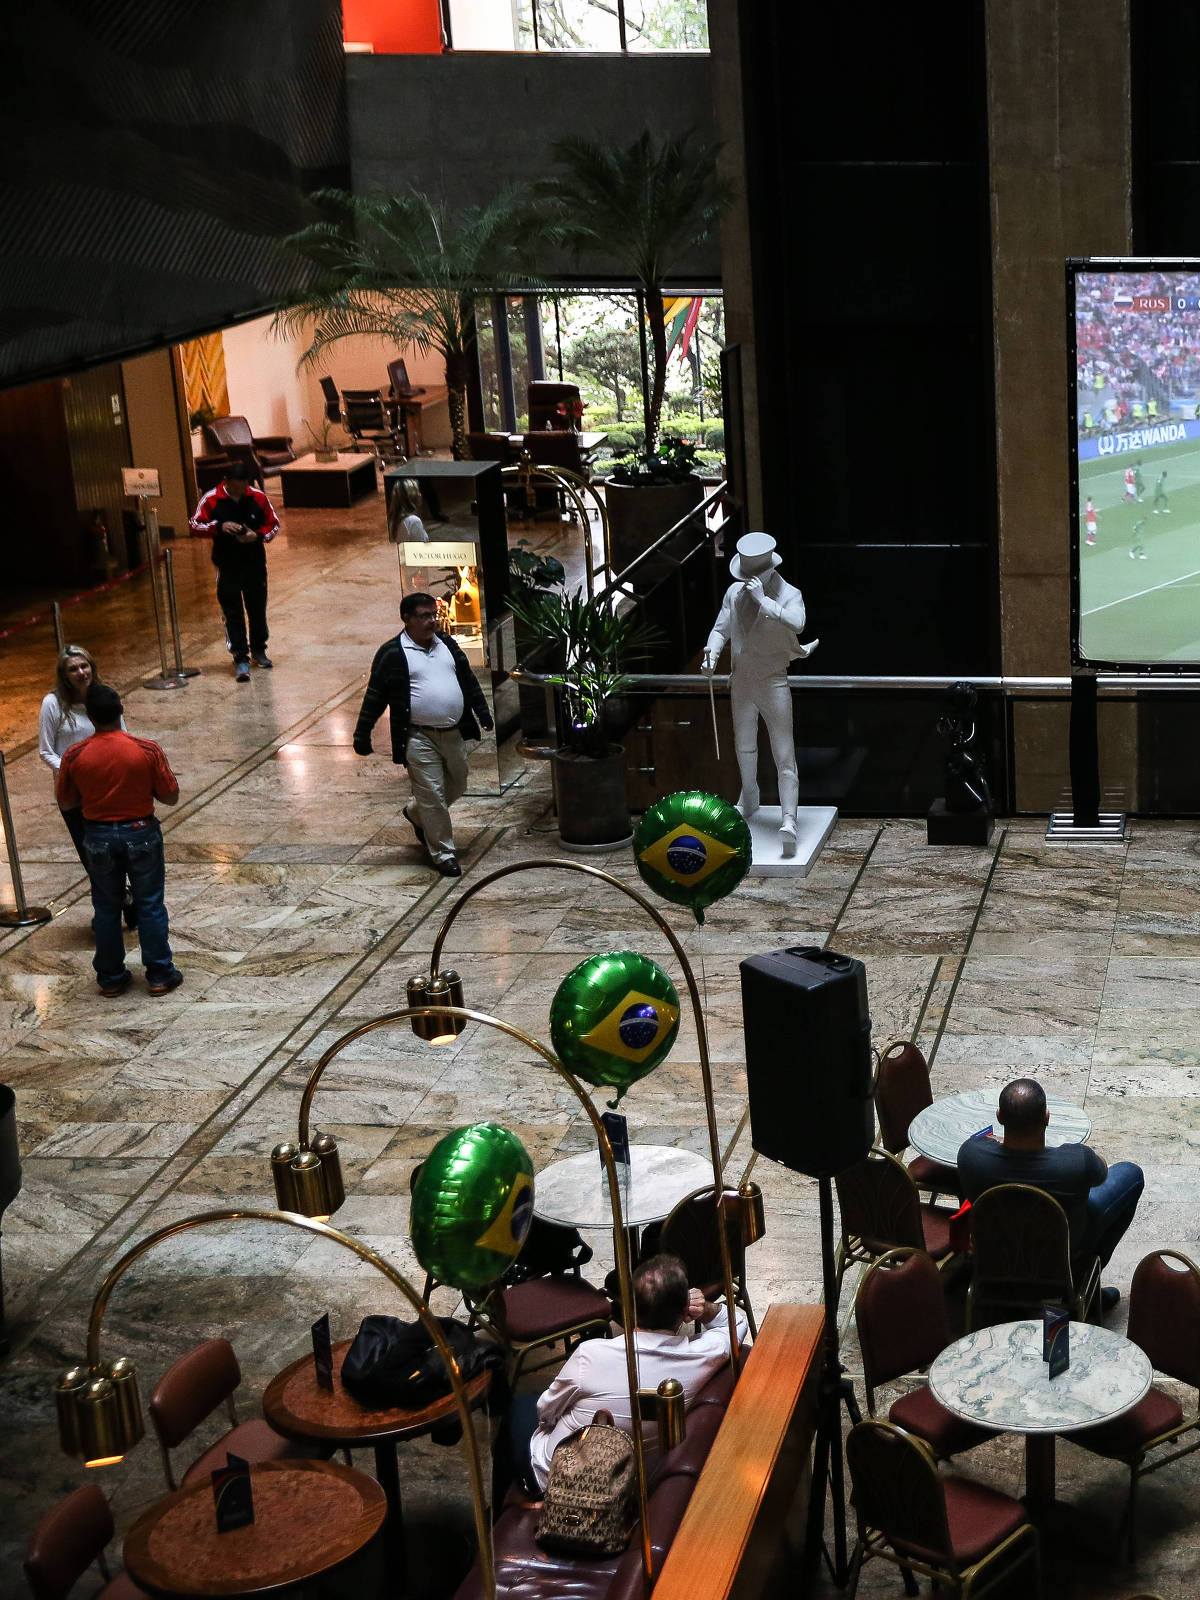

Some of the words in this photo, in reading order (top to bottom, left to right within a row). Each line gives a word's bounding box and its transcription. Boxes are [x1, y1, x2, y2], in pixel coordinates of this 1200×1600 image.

[1139, 299, 1165, 309] RUS
[1177, 299, 1186, 309] 0
[1141, 423, 1187, 446] WANDA
